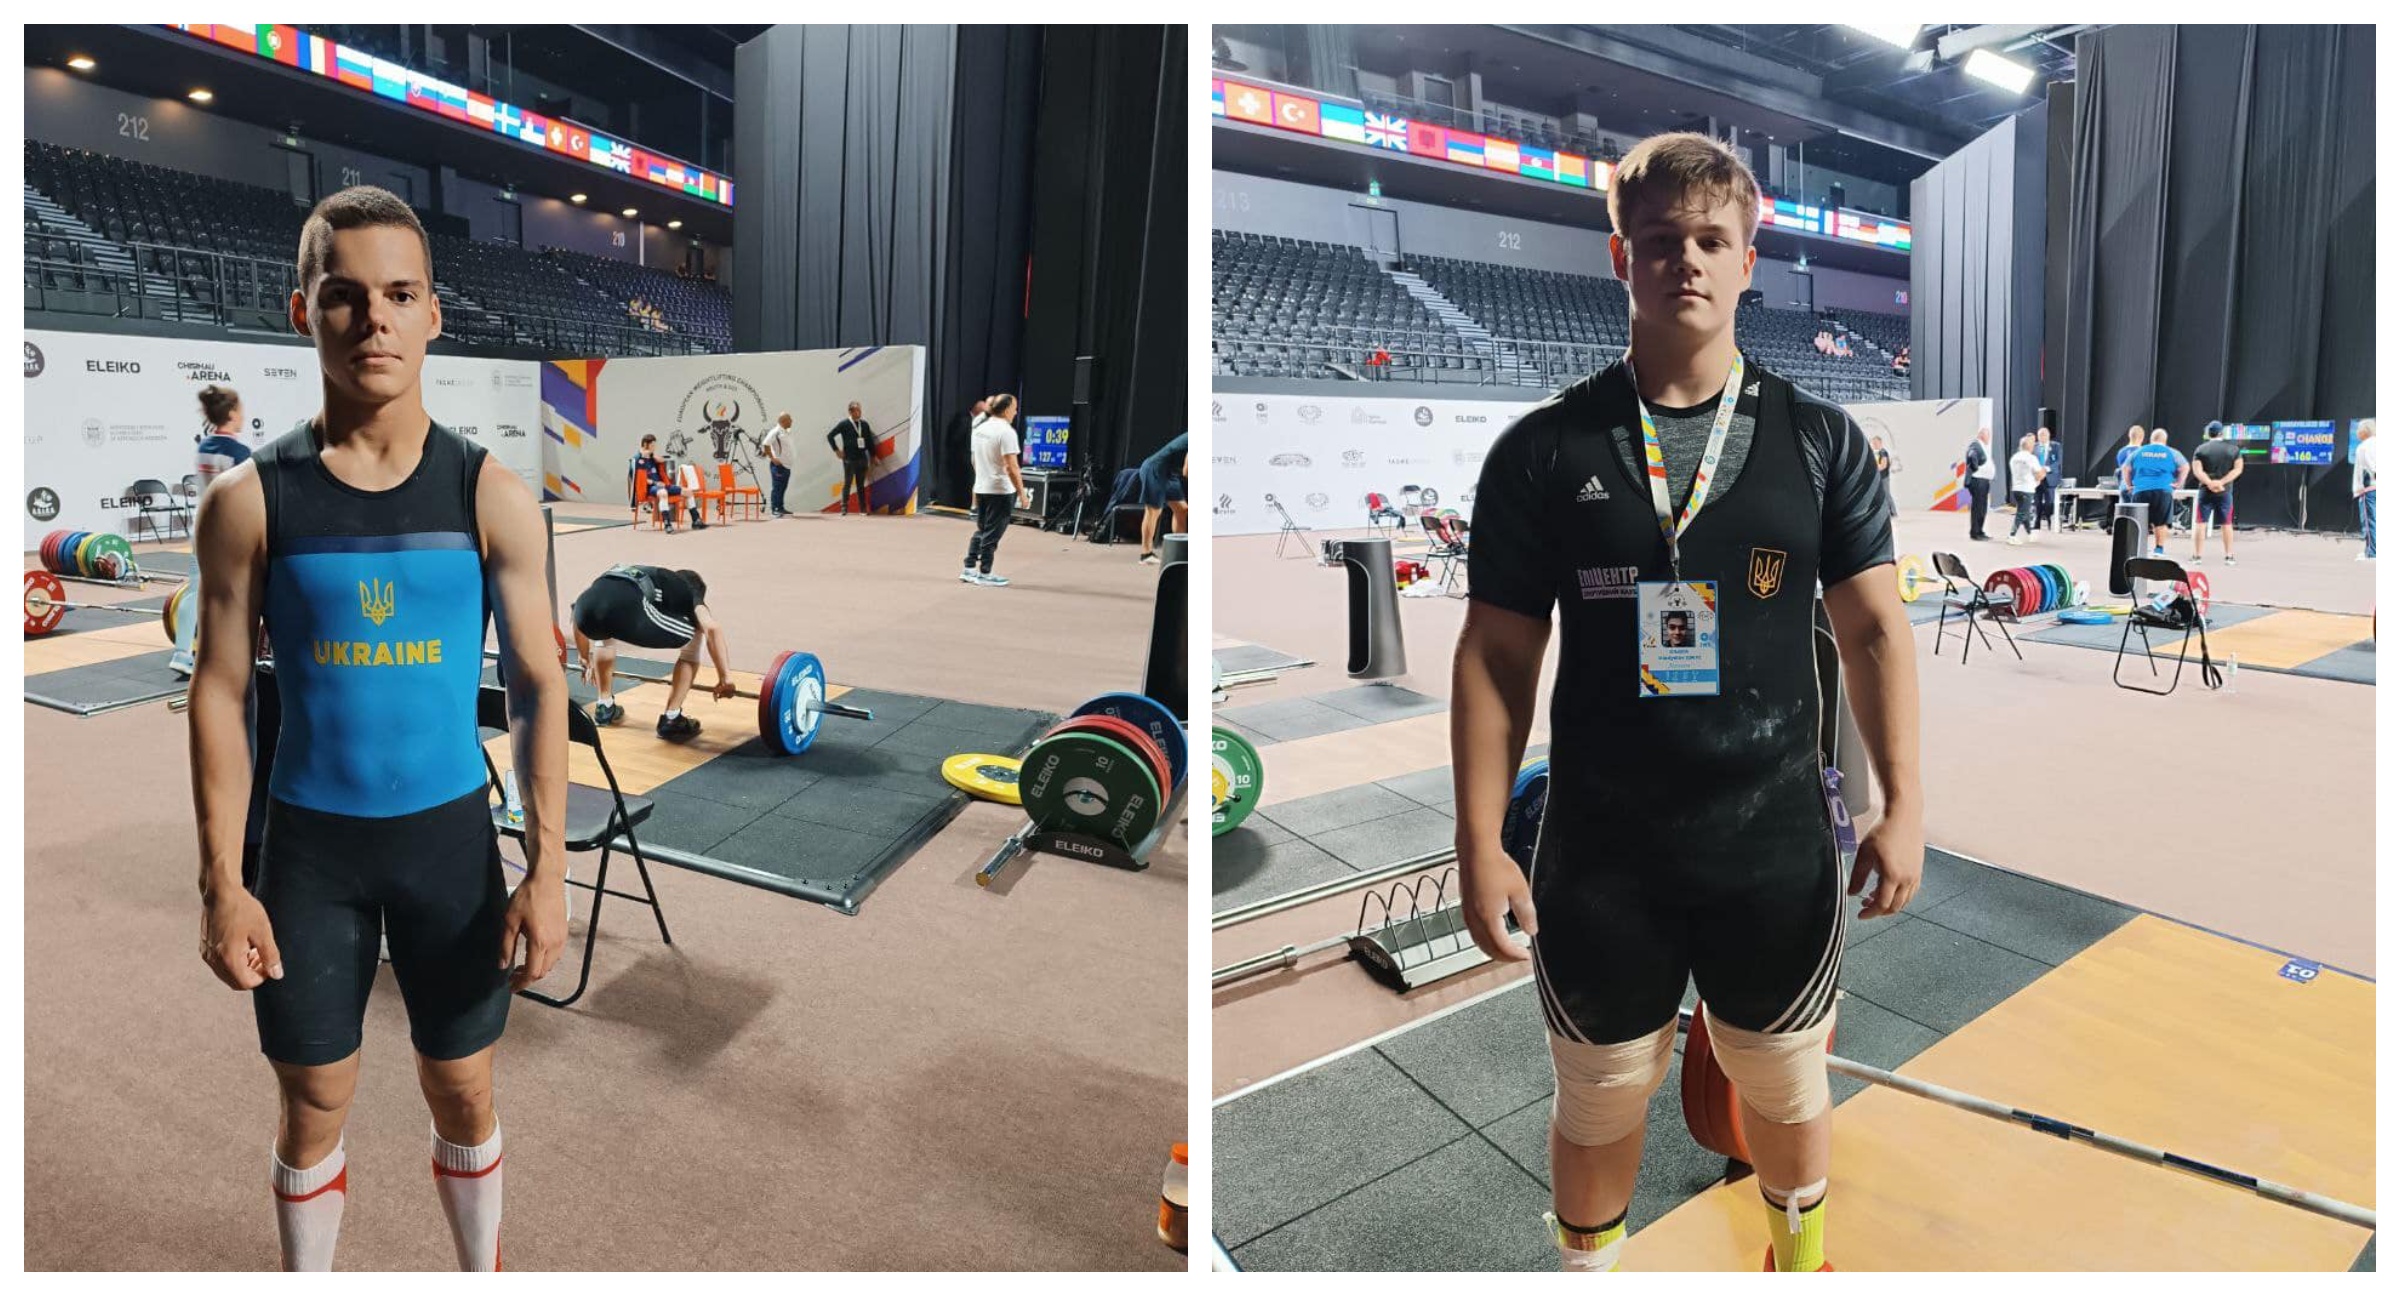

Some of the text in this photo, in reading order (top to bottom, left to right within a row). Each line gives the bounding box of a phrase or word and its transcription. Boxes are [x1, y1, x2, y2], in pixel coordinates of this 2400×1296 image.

[118, 112, 149, 141] 212
[343, 167, 360, 186] 211
[1499, 231, 1521, 250] 212
[86, 360, 141, 374] ELEIKO
[191, 371, 231, 382] ARENA
[1455, 415, 1487, 423] ELEIKO
[1045, 428, 1069, 445] 0:39
[2294, 451, 2312, 462] 160
[1576, 490, 1610, 503] adidas
[313, 638, 443, 667] UKRAINE
[1095, 756, 1109, 769] 10
[1030, 754, 1060, 799] ELEIKO
[1236, 774, 1251, 785] 10
[1111, 794, 1150, 839] ELEIKO
[1055, 840, 1105, 859] ELEIKO
